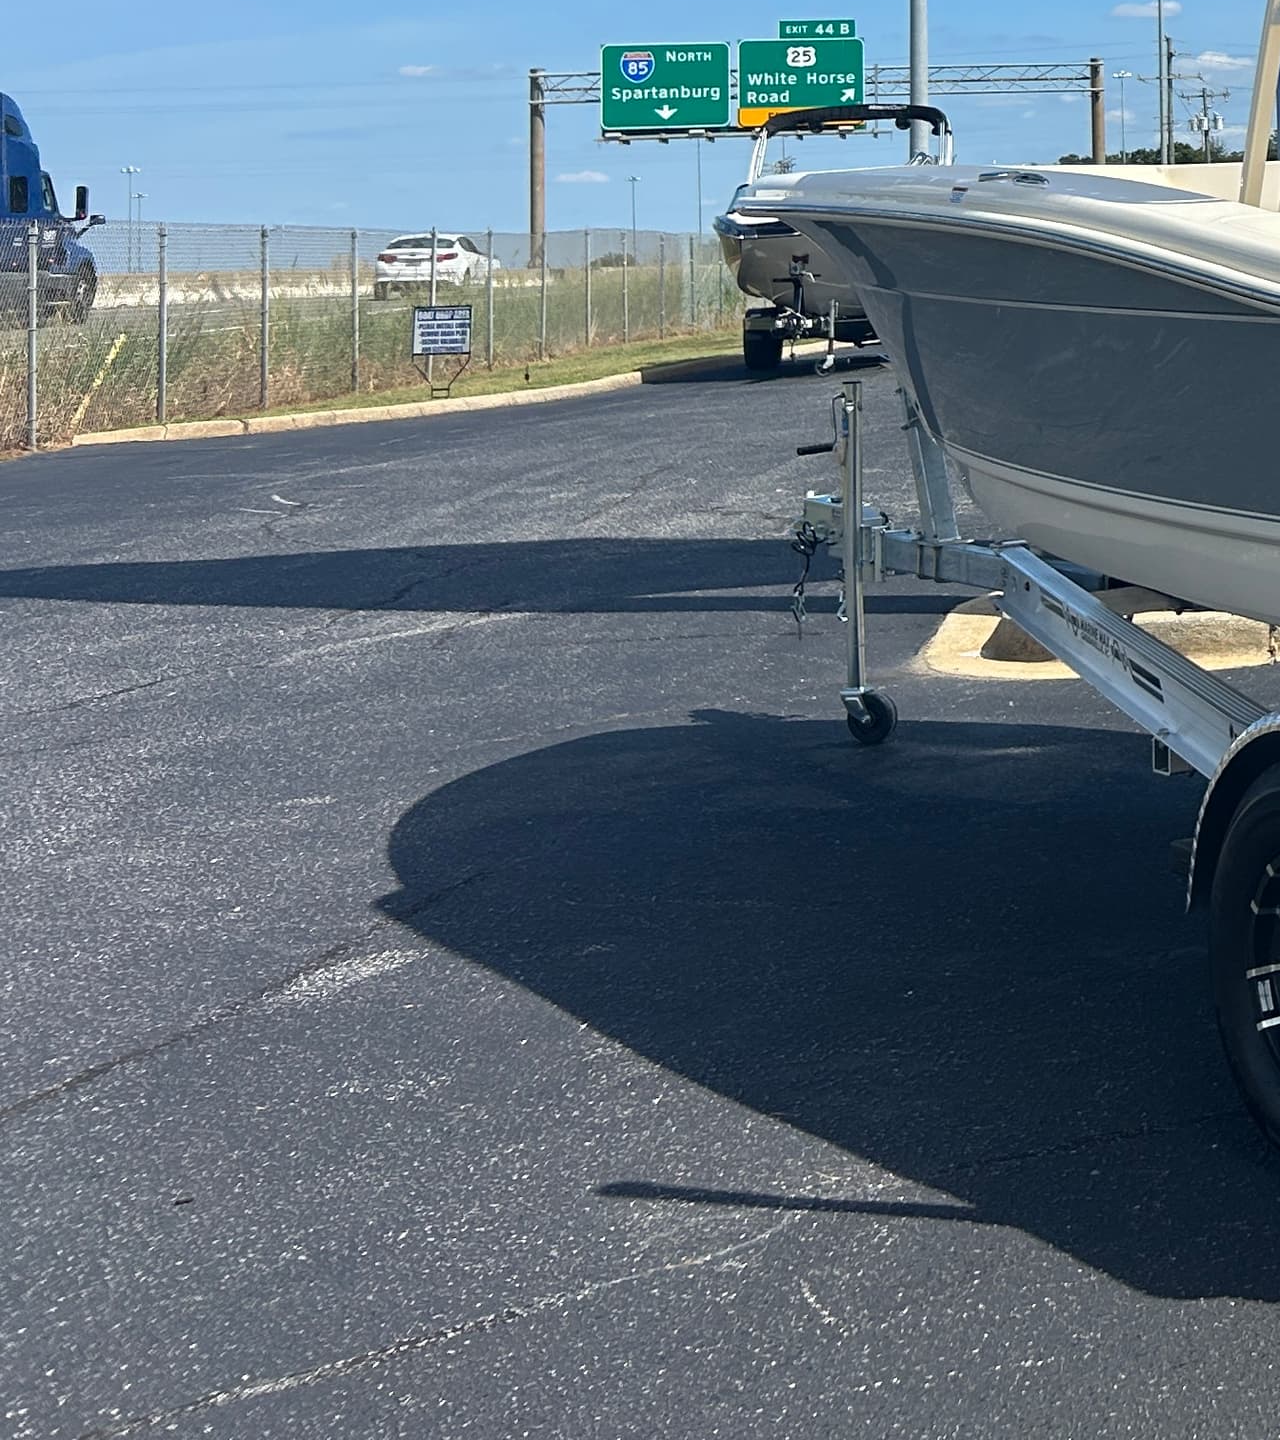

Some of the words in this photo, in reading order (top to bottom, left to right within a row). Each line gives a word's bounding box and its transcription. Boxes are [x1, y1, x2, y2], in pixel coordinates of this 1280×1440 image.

[785, 25, 808, 34] EXIT
[815, 23, 834, 35] 44
[840, 23, 850, 34] B
[665, 51, 712, 62] NORTH
[791, 50, 812, 63] 25
[628, 61, 649, 75] 85
[747, 72, 798, 86] White
[806, 72, 856, 84] Horse
[611, 85, 721, 102] Spartanburg
[747, 90, 790, 104] Road
